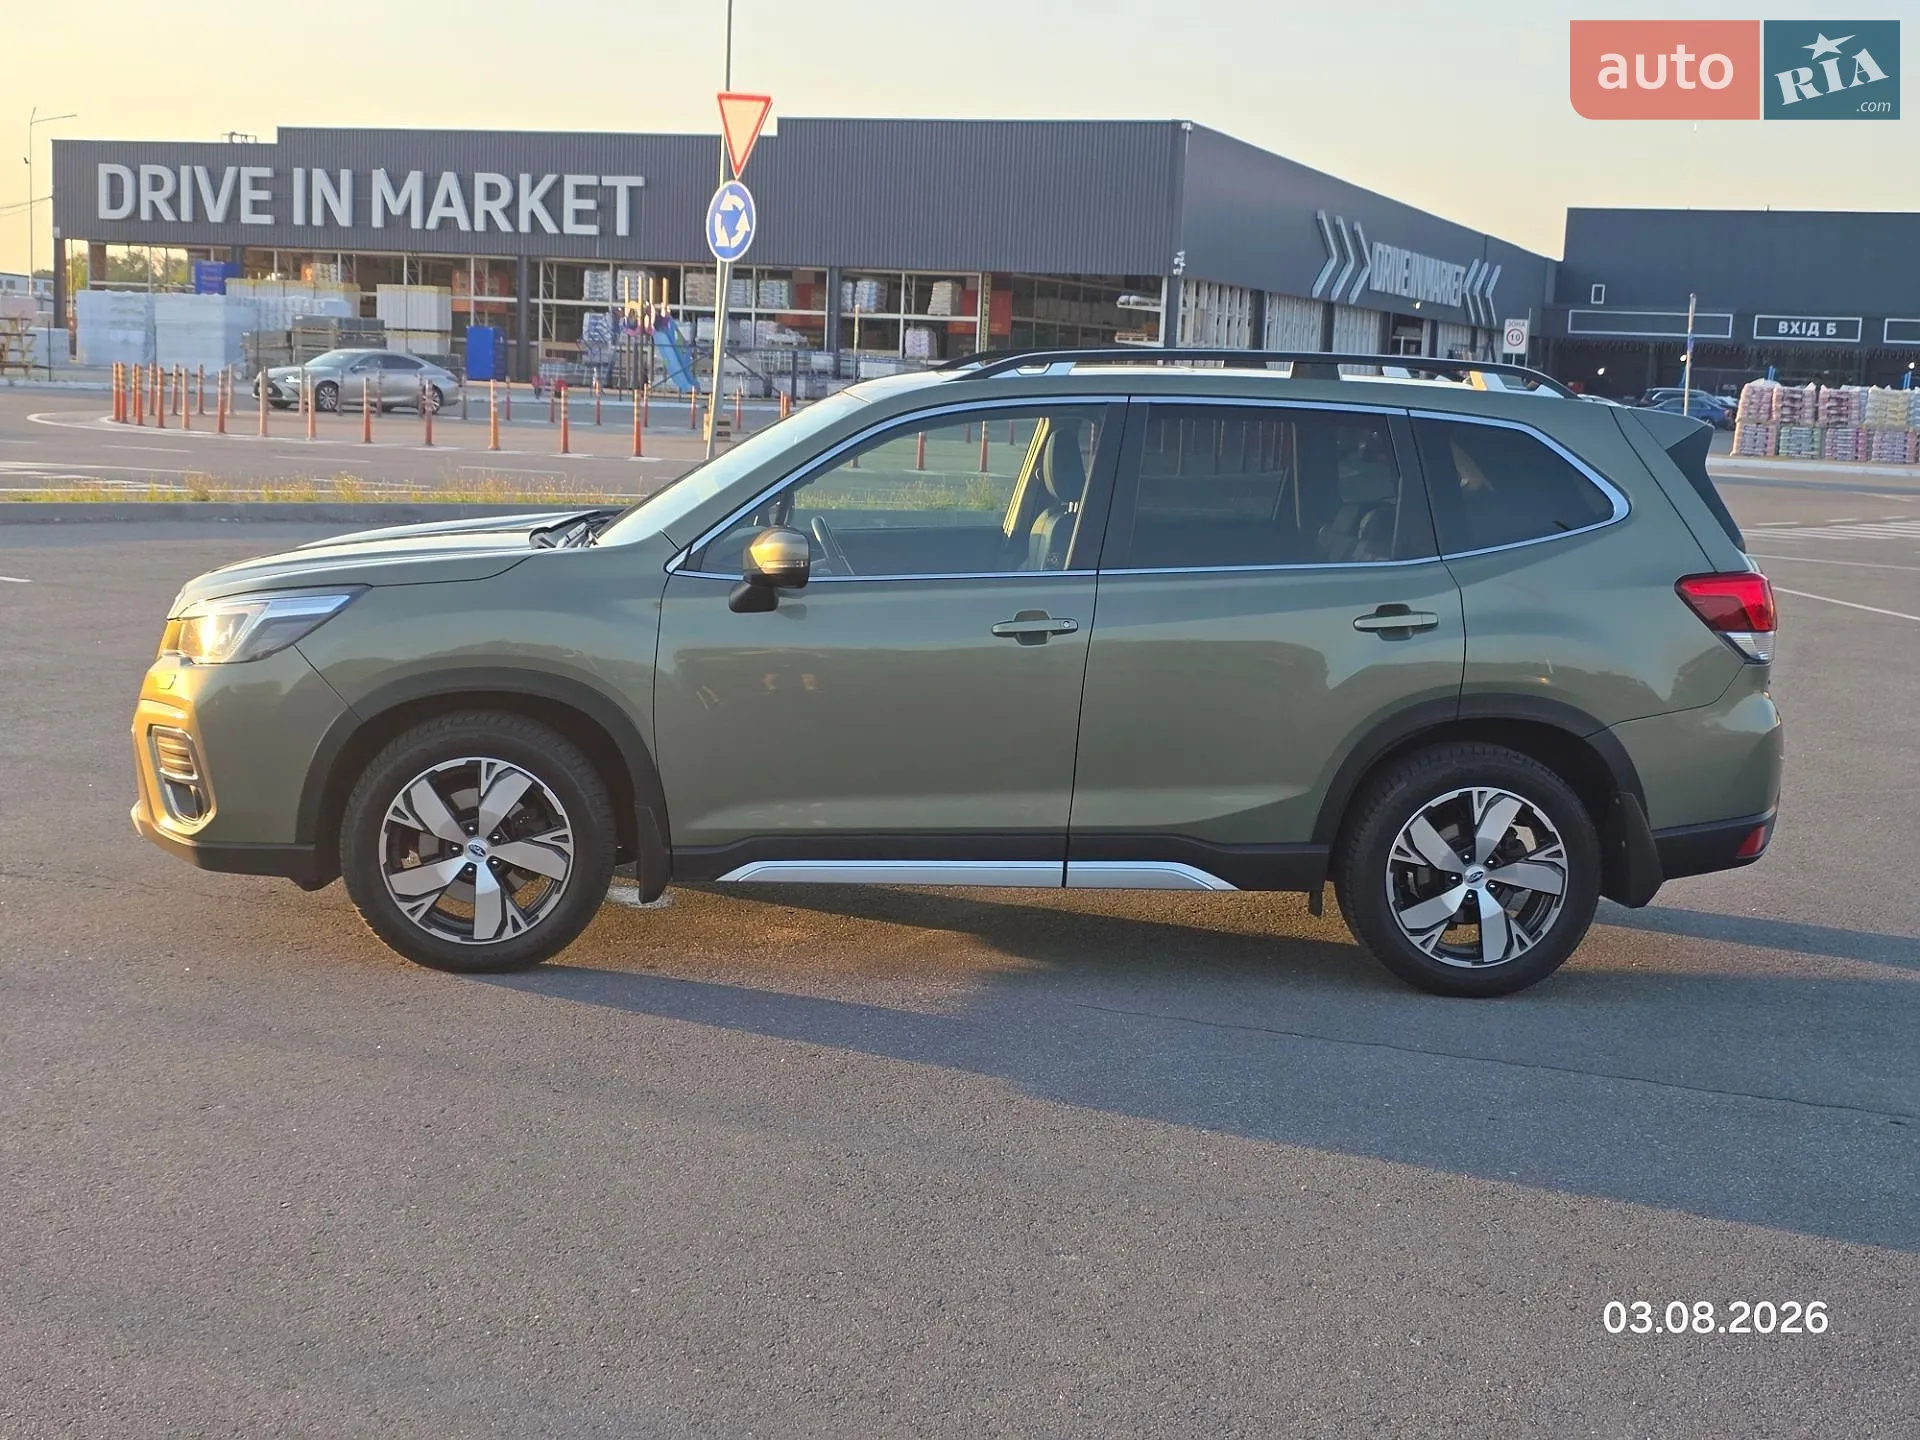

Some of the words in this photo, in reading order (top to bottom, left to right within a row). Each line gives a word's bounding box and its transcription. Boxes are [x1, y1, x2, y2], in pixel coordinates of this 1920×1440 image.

[98, 163, 275, 225] DRIVE
[293, 167, 353, 228] IN
[371, 168, 645, 237] MARKET
[1778, 320, 1820, 337] ВХІД
[1826, 322, 1837, 336] Б
[1510, 333, 1521, 342] 10
